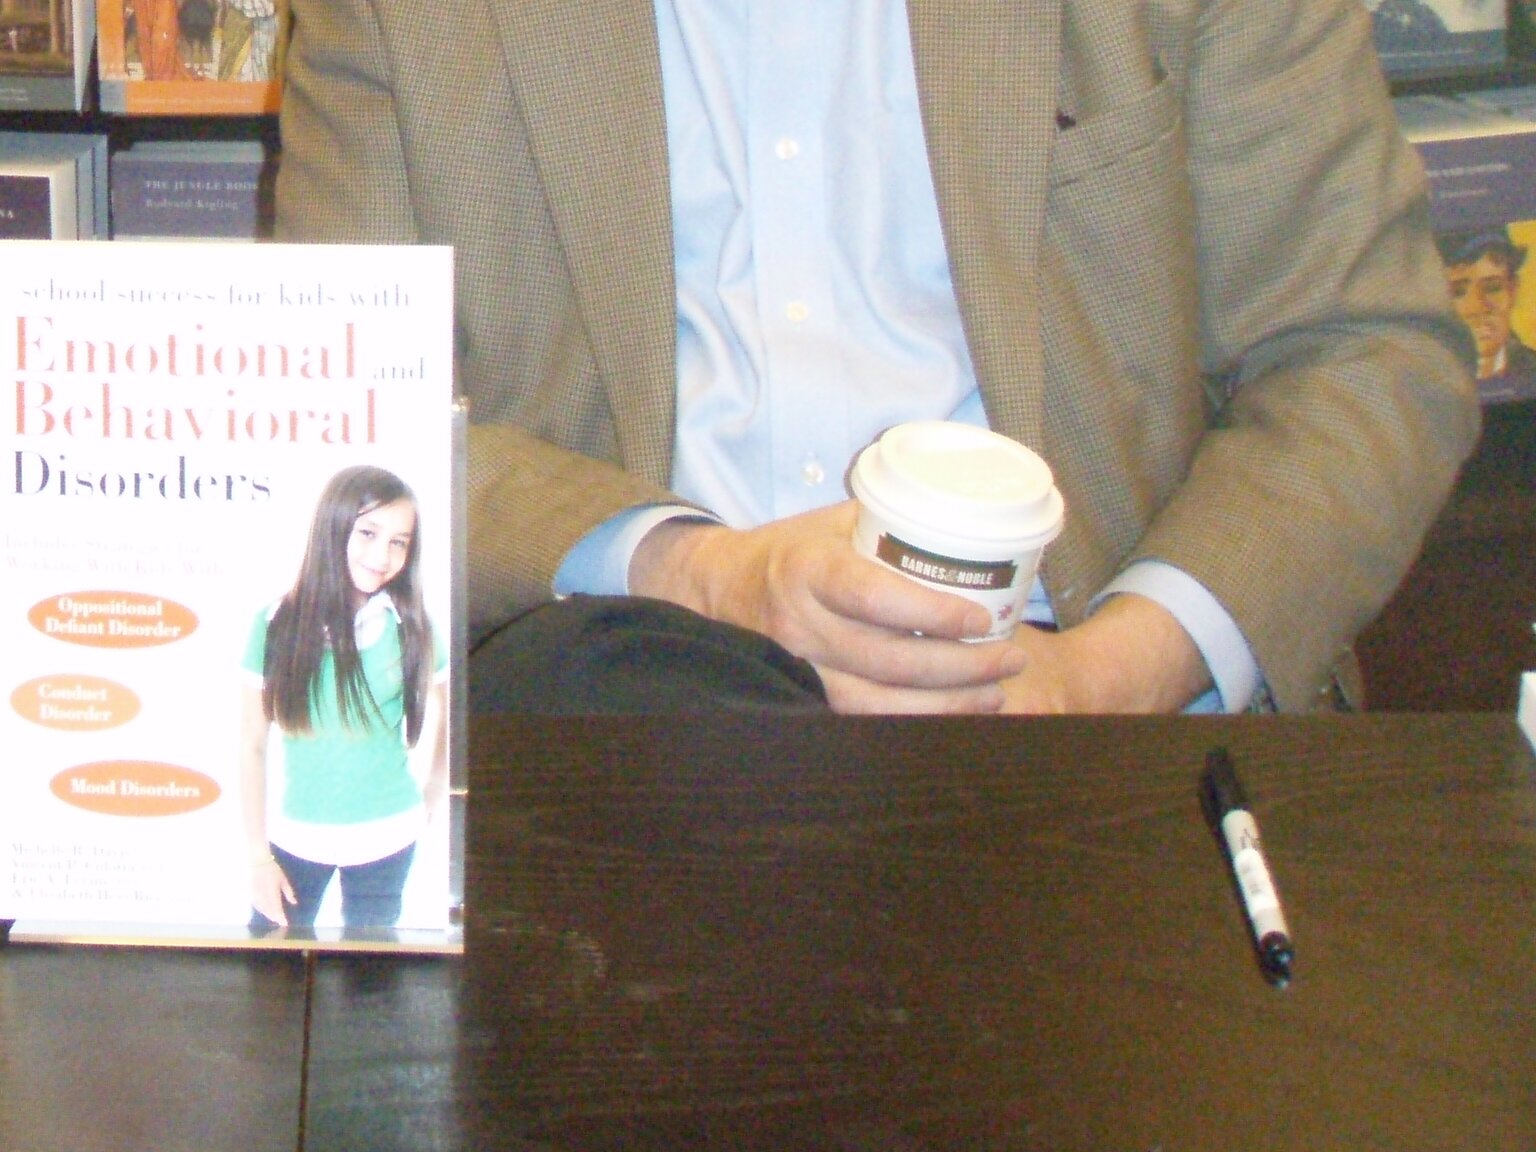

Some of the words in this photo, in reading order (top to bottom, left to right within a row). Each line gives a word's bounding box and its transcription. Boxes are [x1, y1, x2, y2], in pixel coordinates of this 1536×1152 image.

[145, 179, 171, 193] THE
[173, 179, 221, 193] JUNGLE
[196, 198, 239, 214] Kipling
[21, 279, 105, 303] school
[116, 288, 217, 304] success
[229, 283, 265, 306] for
[279, 282, 337, 307] kids
[348, 283, 412, 307] with
[15, 314, 356, 379] Emotional
[372, 357, 426, 380] and
[14, 379, 377, 444] Behavioral
[13, 450, 272, 501] Disorders
[900, 554, 946, 581] BARNES
[957, 570, 995, 586] NOBLE
[56, 596, 163, 618] Oppositional
[44, 616, 105, 635] Defiant
[108, 618, 182, 639] Disorder
[37, 683, 108, 702] Conduct
[39, 704, 113, 723] Disorder
[70, 777, 118, 796] Mood
[120, 779, 201, 799] Disorders
